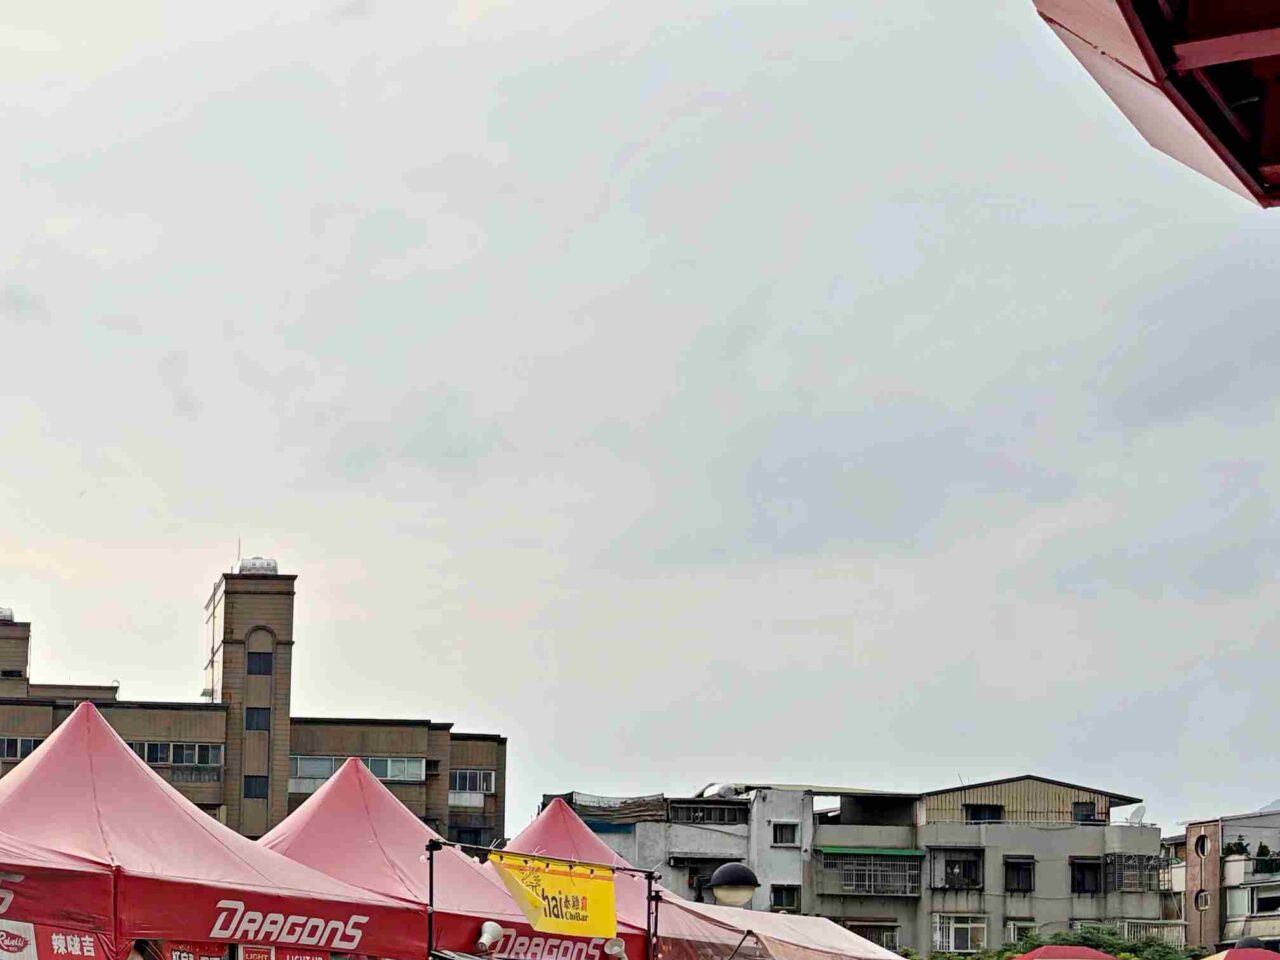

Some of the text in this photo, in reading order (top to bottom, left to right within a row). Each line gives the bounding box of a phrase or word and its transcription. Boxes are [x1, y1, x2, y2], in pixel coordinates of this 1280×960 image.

[565, 910, 589, 922] ChiBar
[209, 899, 370, 951] DRAGONS
[245, 953, 269, 960] LIGHT
